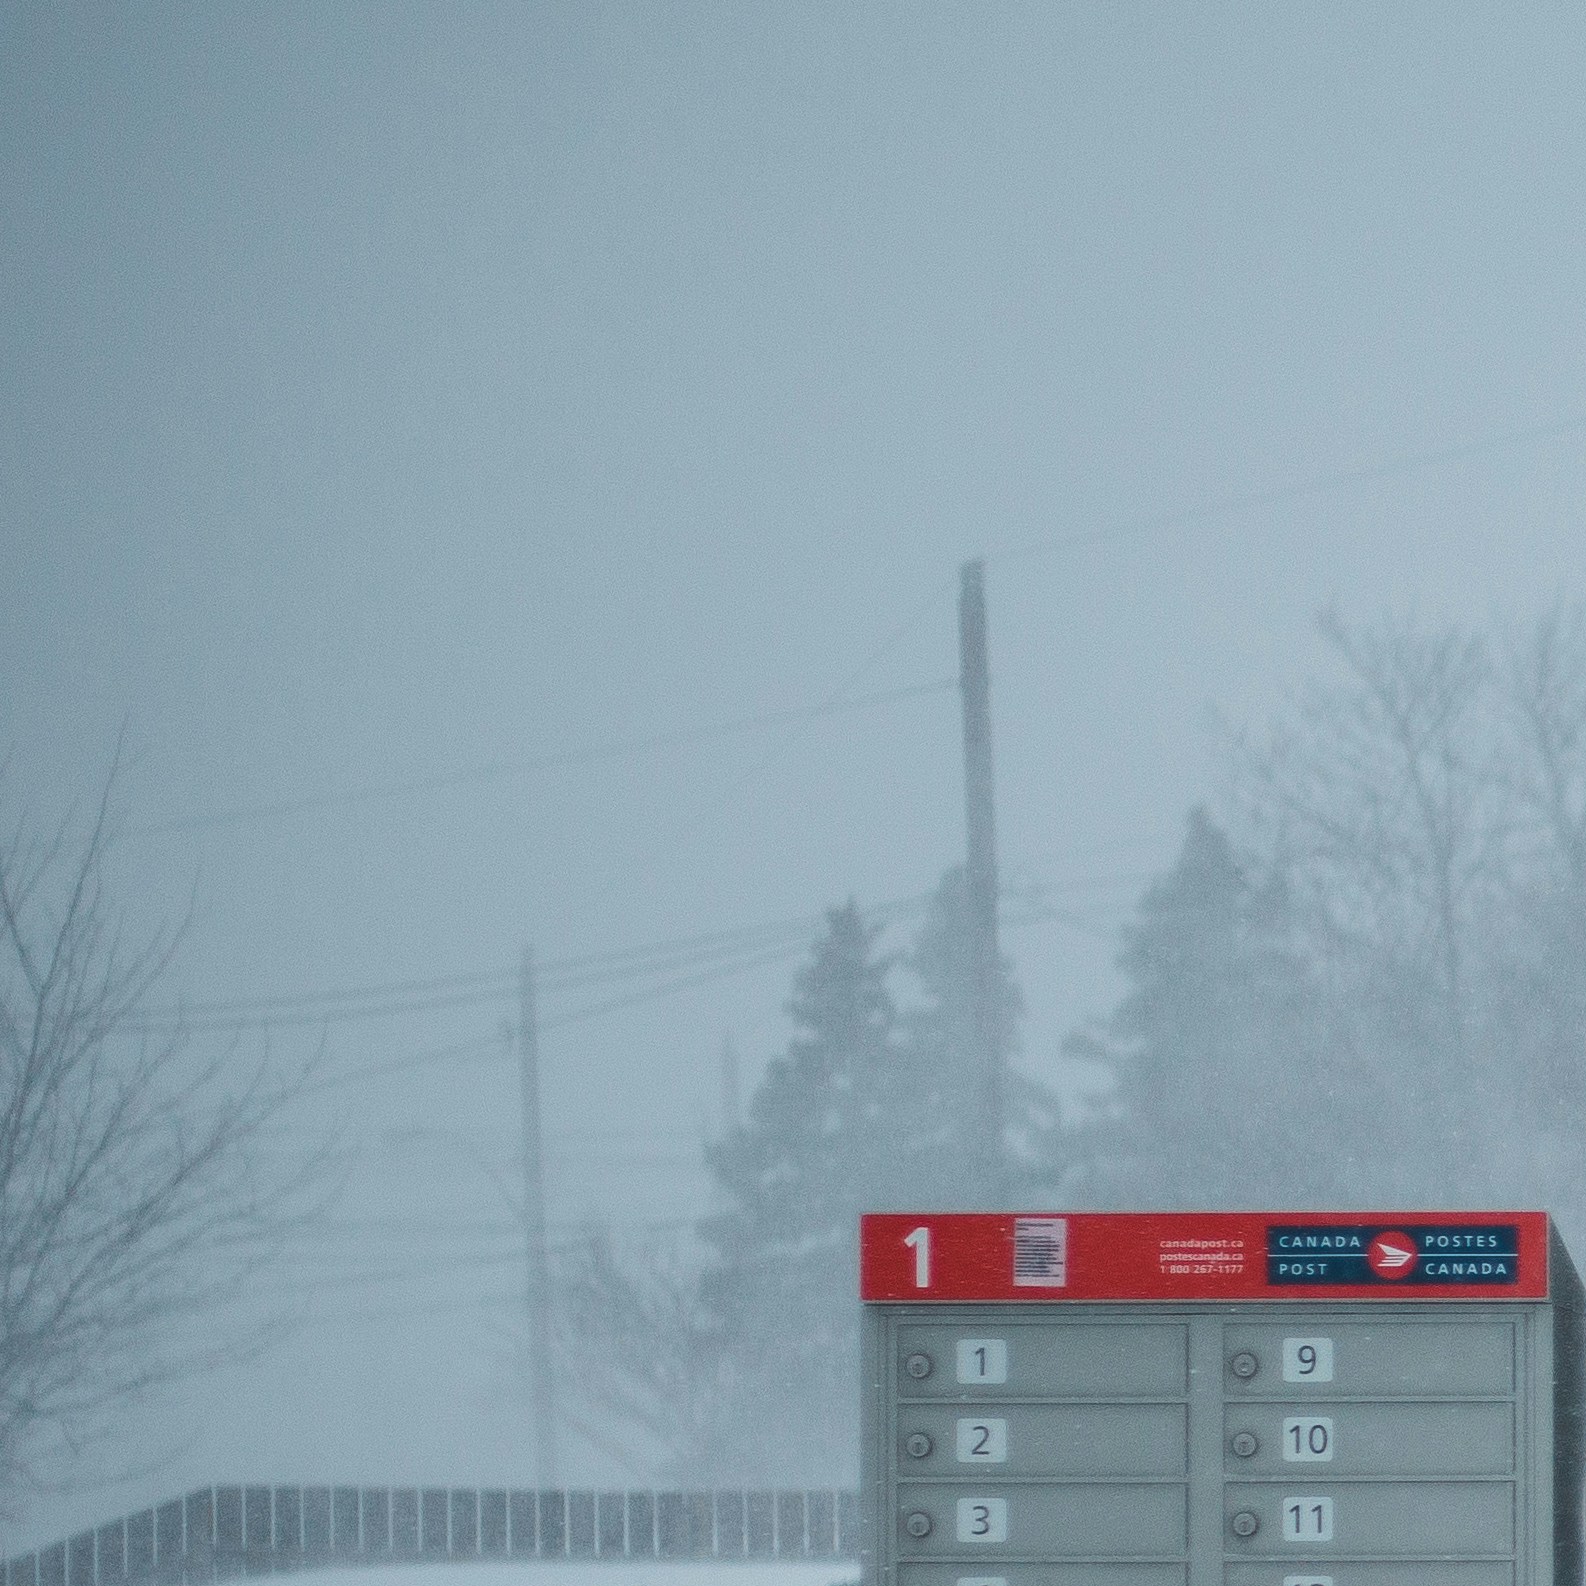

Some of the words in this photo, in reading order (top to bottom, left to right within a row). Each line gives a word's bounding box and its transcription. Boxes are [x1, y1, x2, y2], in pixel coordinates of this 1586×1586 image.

[1160, 1239, 1244, 1249] canadapost.ca
[1279, 1236, 1361, 1248] CANADA
[1425, 1235, 1497, 1247] POSTES
[904, 1226, 928, 1288] 1
[1160, 1252, 1244, 1263] postescanada.ca
[1170, 1265, 1190, 1273] 800
[1279, 1263, 1328, 1275] POST
[1425, 1263, 1507, 1275] CANADA
[974, 1346, 986, 1377] 1
[1297, 1344, 1317, 1375] 9
[971, 1425, 990, 1456] 2
[1289, 1424, 1329, 1455] 10
[971, 1505, 990, 1536] 3
[1289, 1504, 1323, 1534] 11
